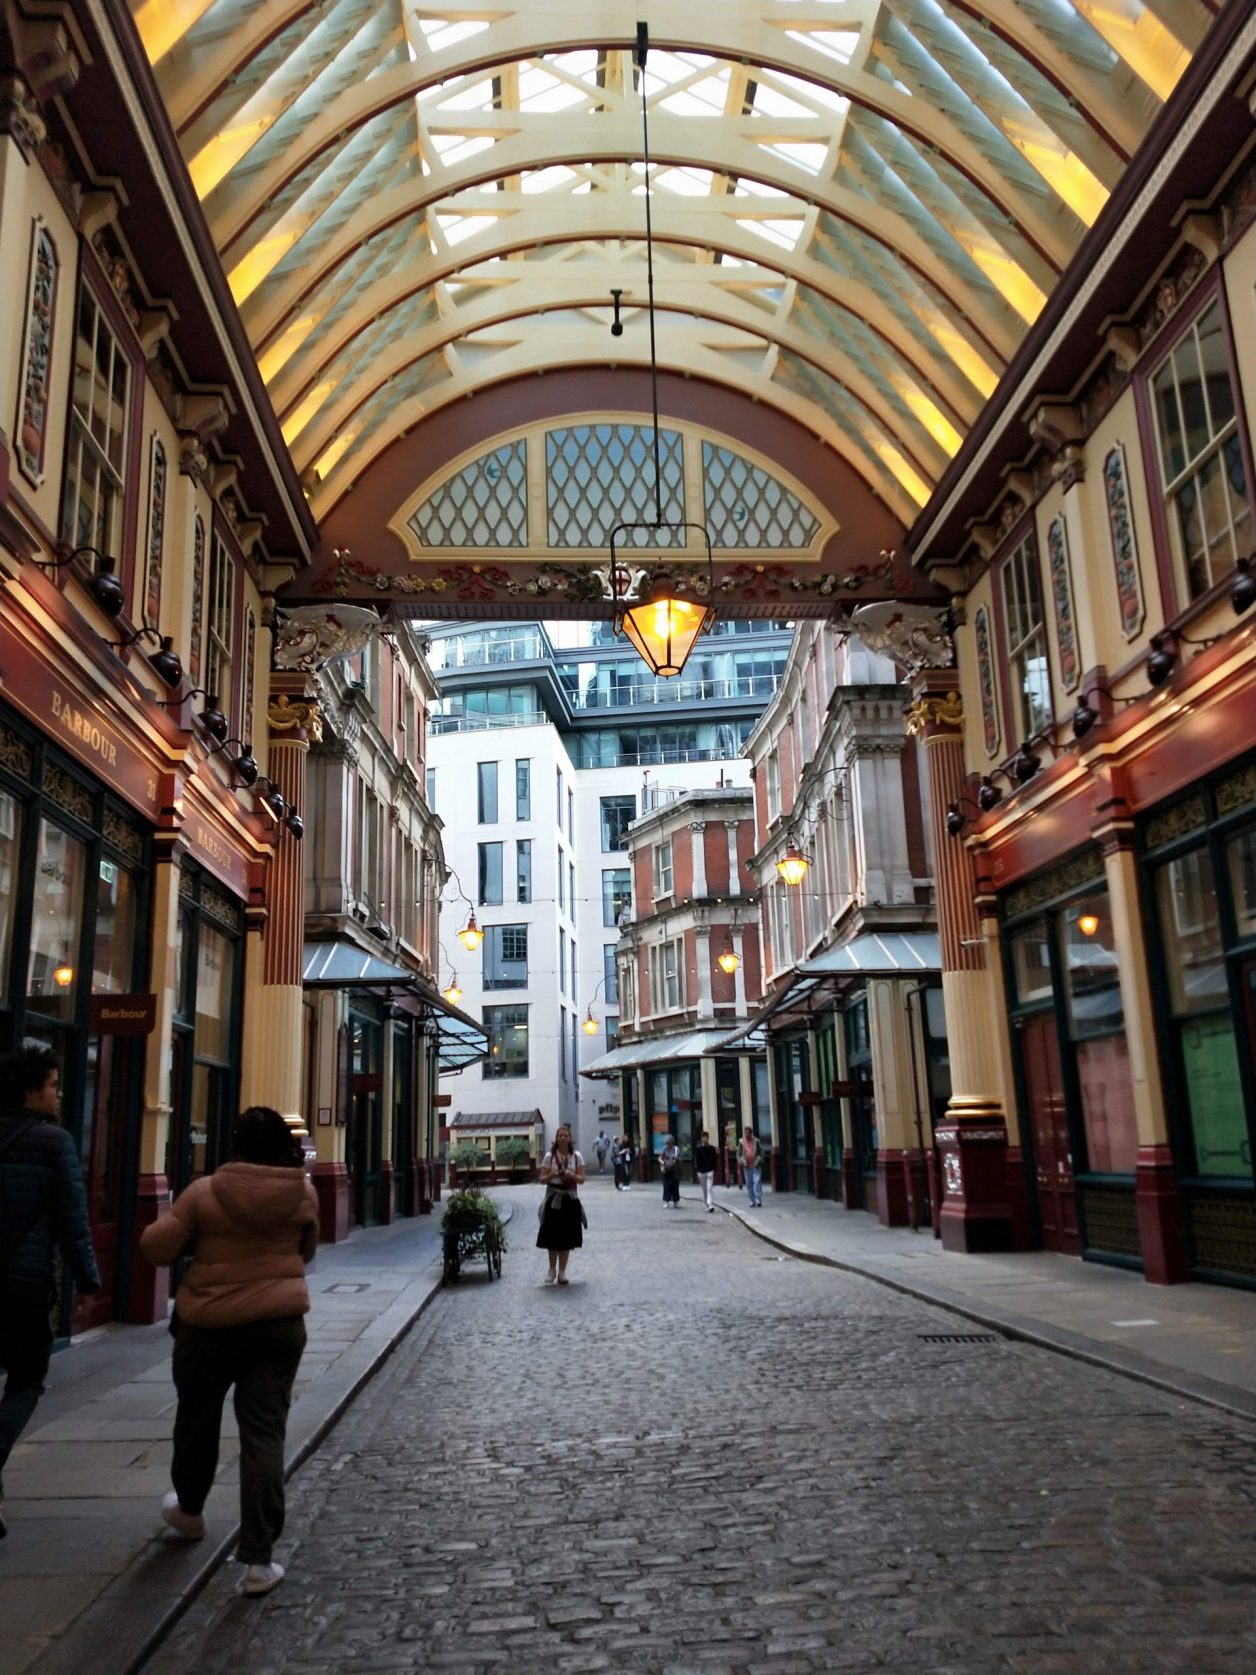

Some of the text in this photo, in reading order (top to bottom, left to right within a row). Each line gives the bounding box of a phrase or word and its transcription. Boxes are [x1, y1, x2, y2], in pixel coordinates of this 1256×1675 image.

[51, 690, 117, 767] BARBOUR
[197, 827, 232, 871] BARBOUR
[100, 1008, 147, 1019] Barbour
